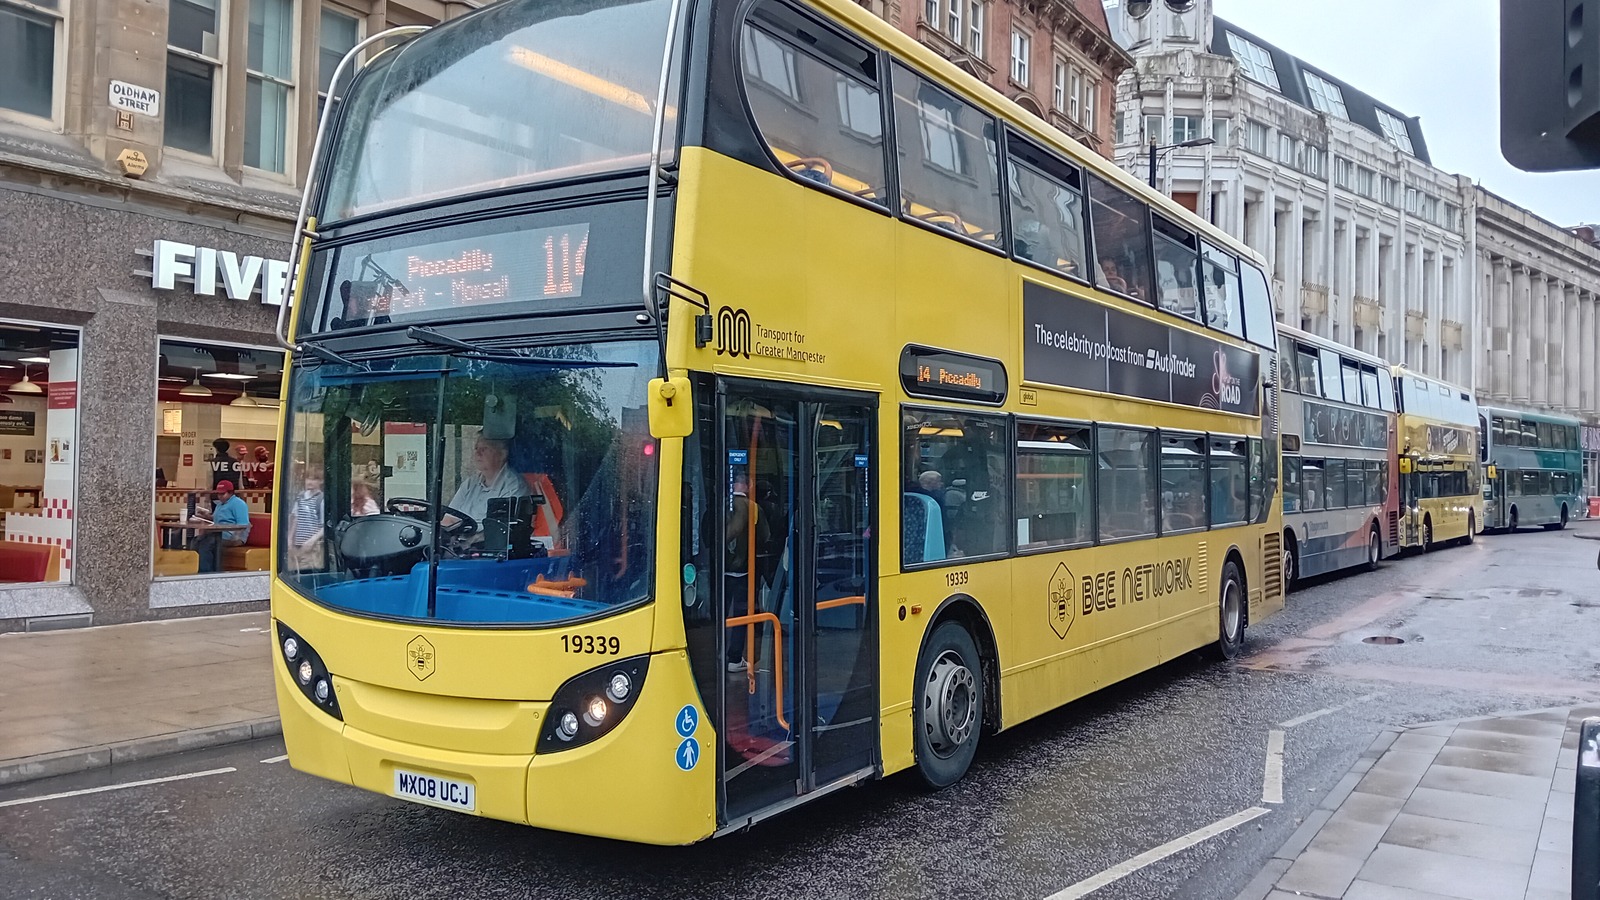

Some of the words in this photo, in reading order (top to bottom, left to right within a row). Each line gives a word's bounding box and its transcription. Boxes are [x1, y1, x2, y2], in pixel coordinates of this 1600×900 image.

[113, 84, 156, 104] OLDHAM
[118, 97, 150, 112] STREET
[126, 155, 146, 164] Modern
[152, 239, 298, 307] FIVE
[408, 249, 492, 281] Piccadilly
[756, 324, 793, 343] Transport
[794, 331, 805, 344] for
[755, 342, 785, 358] Greater
[786, 346, 826, 364] Manchester
[1035, 323, 1053, 346] The
[1053, 330, 1094, 359] celebrity
[1094, 341, 1127, 363] podcast
[1127, 346, 1145, 367] from
[1154, 350, 1196, 379] AutoTrader
[939, 368, 981, 389] Piccadilly
[1221, 383, 1241, 405] ROAD
[231, 461, 268, 472] GUYS
[945, 573, 969, 587] 19339
[1081, 570, 1116, 616] BEE
[1121, 557, 1193, 606] NETWORK
[560, 634, 620, 656] 19339
[399, 773, 436, 799] MX08
[440, 780, 469, 806] UCJ
